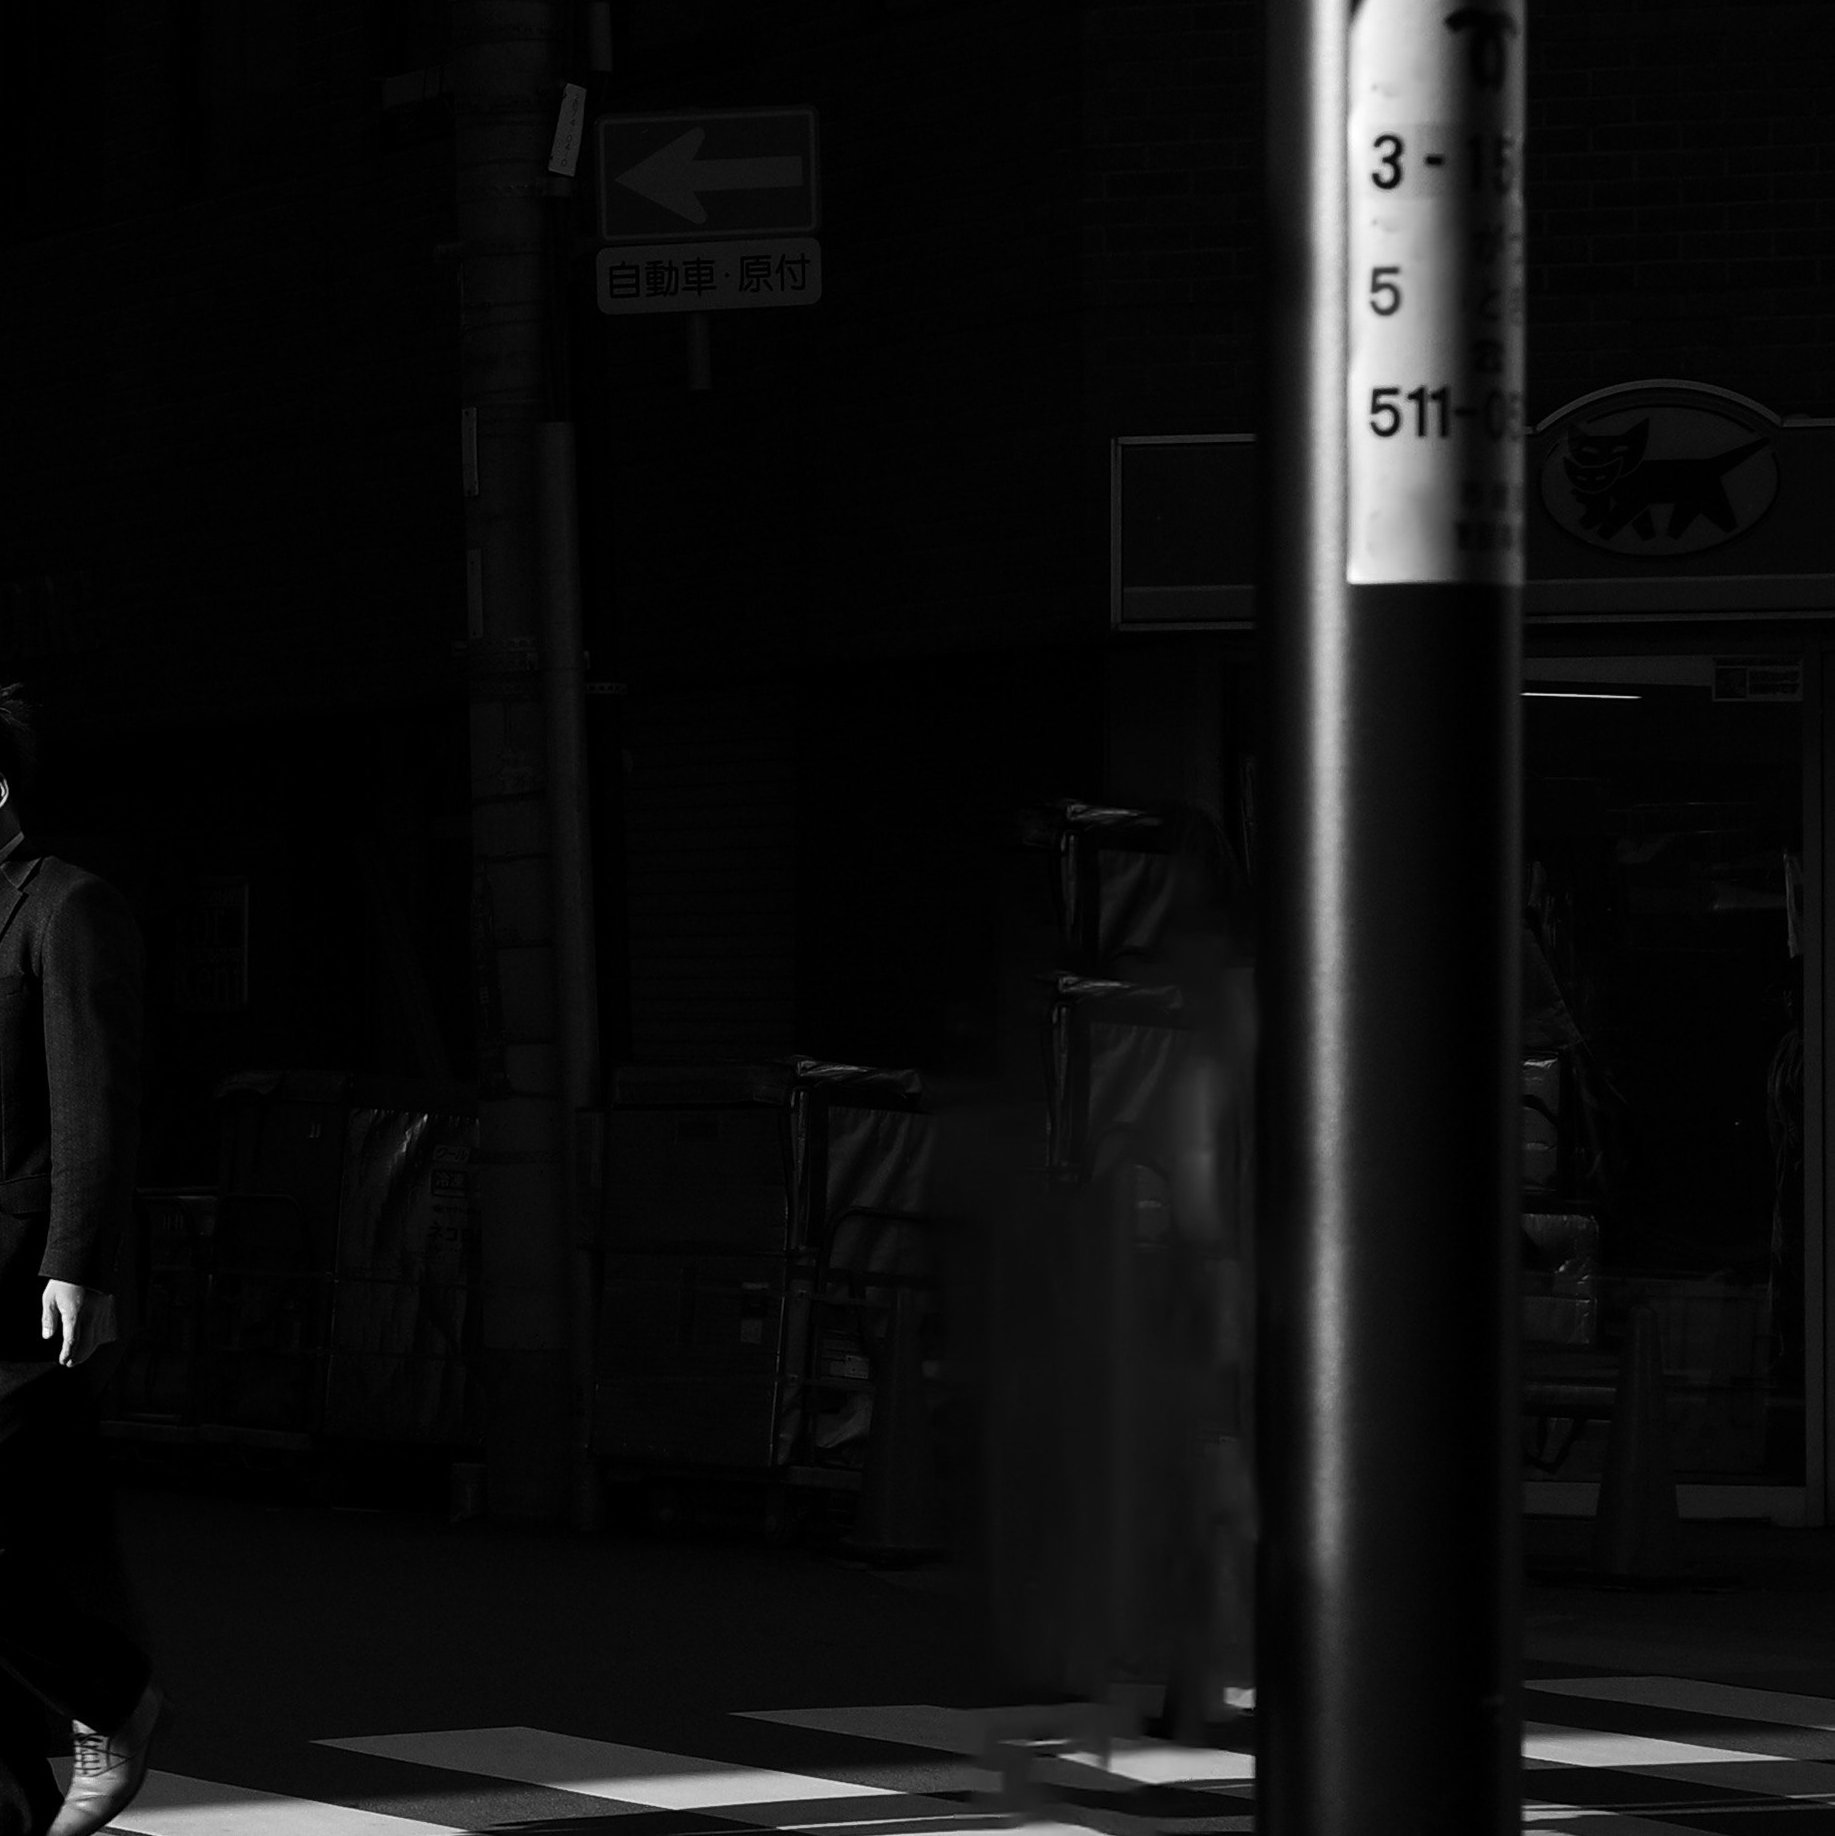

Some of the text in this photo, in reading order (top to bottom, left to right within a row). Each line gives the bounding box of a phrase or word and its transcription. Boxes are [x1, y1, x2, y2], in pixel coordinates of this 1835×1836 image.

[609, 253, 811, 299] 自動車・原付
